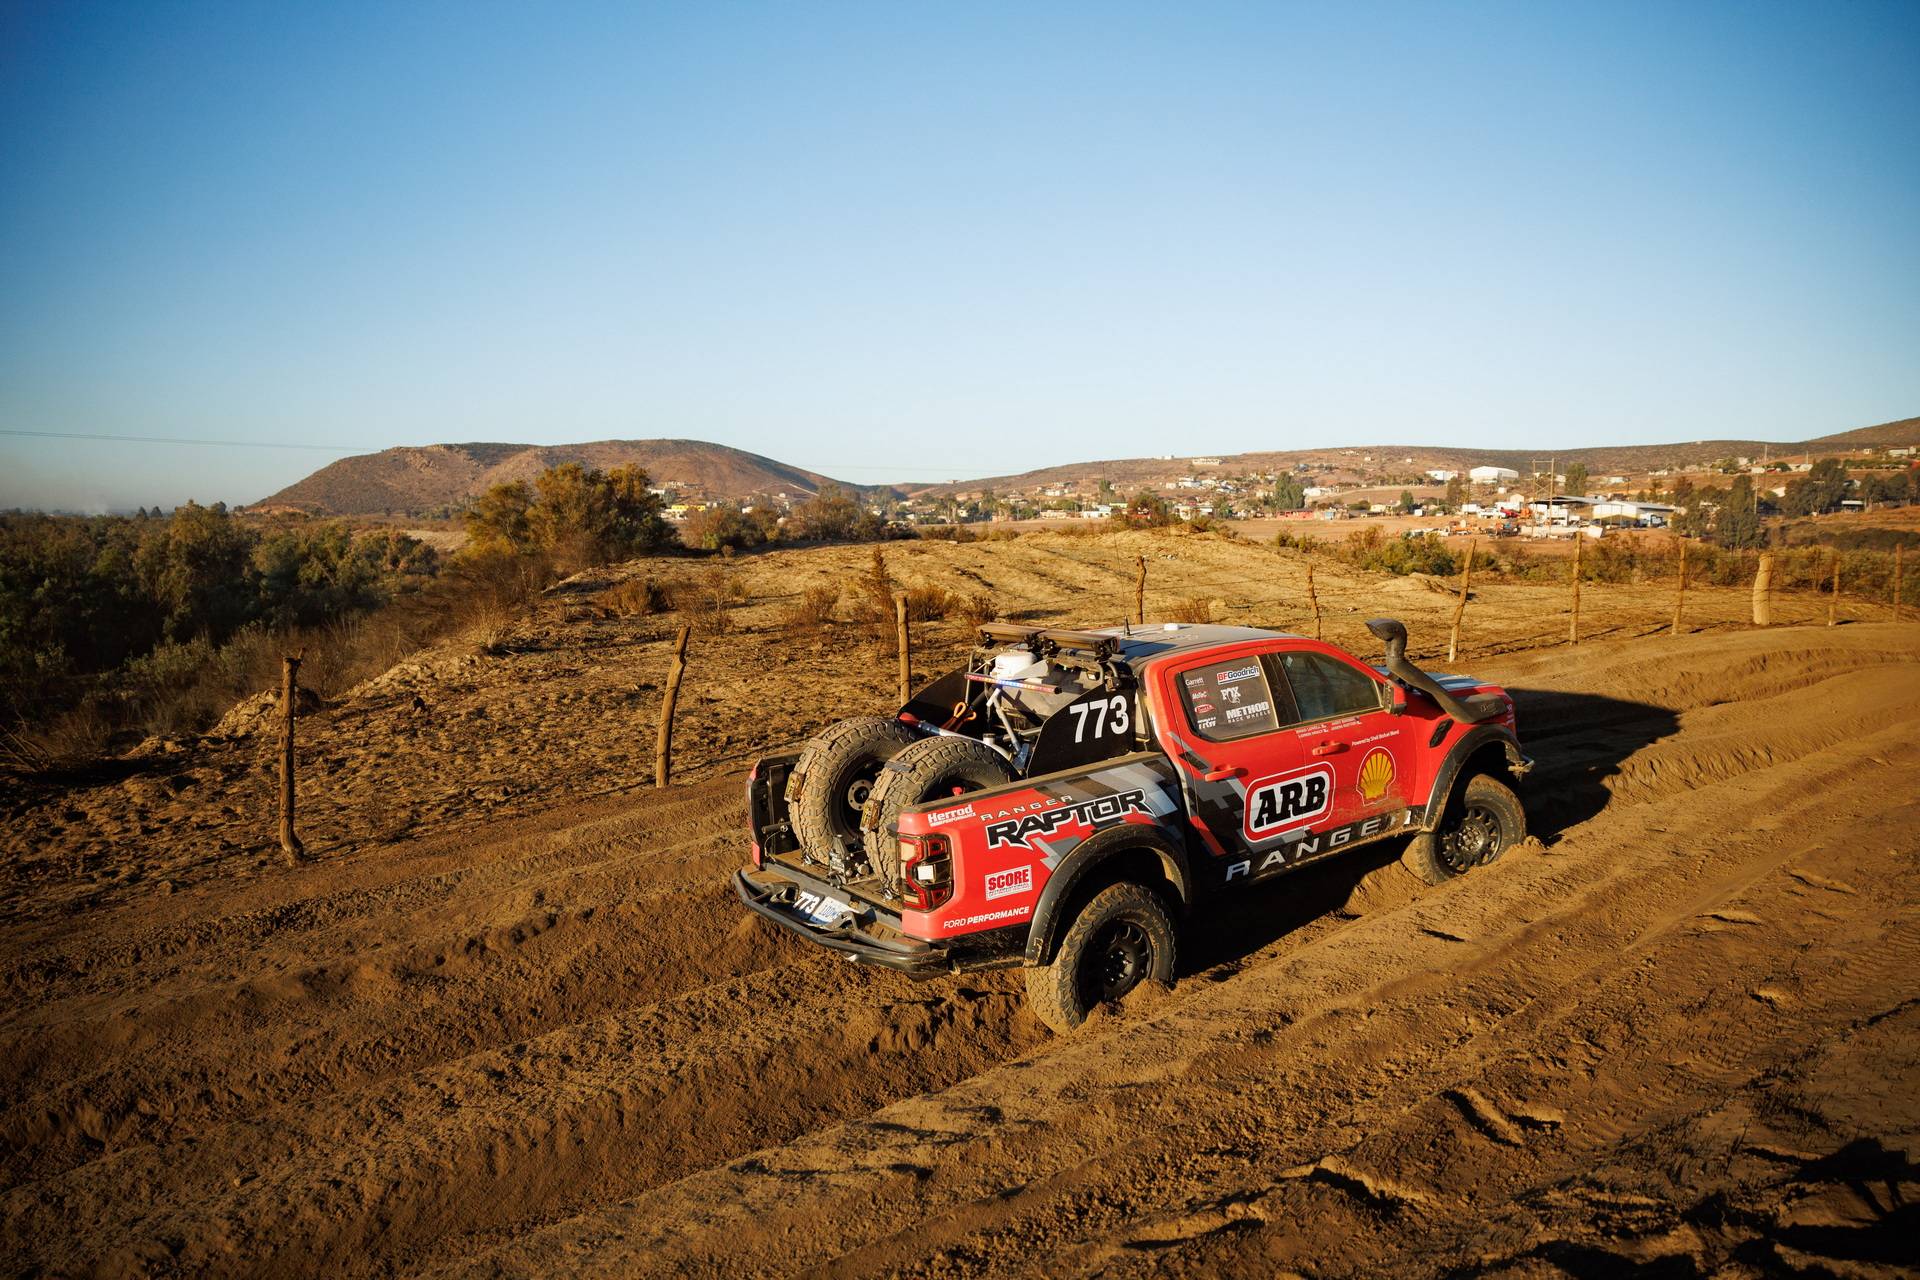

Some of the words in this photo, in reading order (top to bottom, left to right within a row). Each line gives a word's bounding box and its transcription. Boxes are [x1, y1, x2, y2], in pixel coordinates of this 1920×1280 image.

[1218, 665, 1259, 681] BFGoodrich
[1220, 686, 1241, 702] FOX
[1069, 695, 1129, 743] 773
[1226, 701, 1269, 719] METHOD
[928, 804, 973, 823] Herrod
[980, 795, 1073, 821] RANGER
[1254, 776, 1326, 829] ARB
[985, 788, 1157, 850] RAPTOR
[988, 869, 1030, 890] SCORE
[792, 891, 821, 914] 773
[944, 919, 966, 929] FORD
[967, 906, 1030, 924] PERFORMANCE
